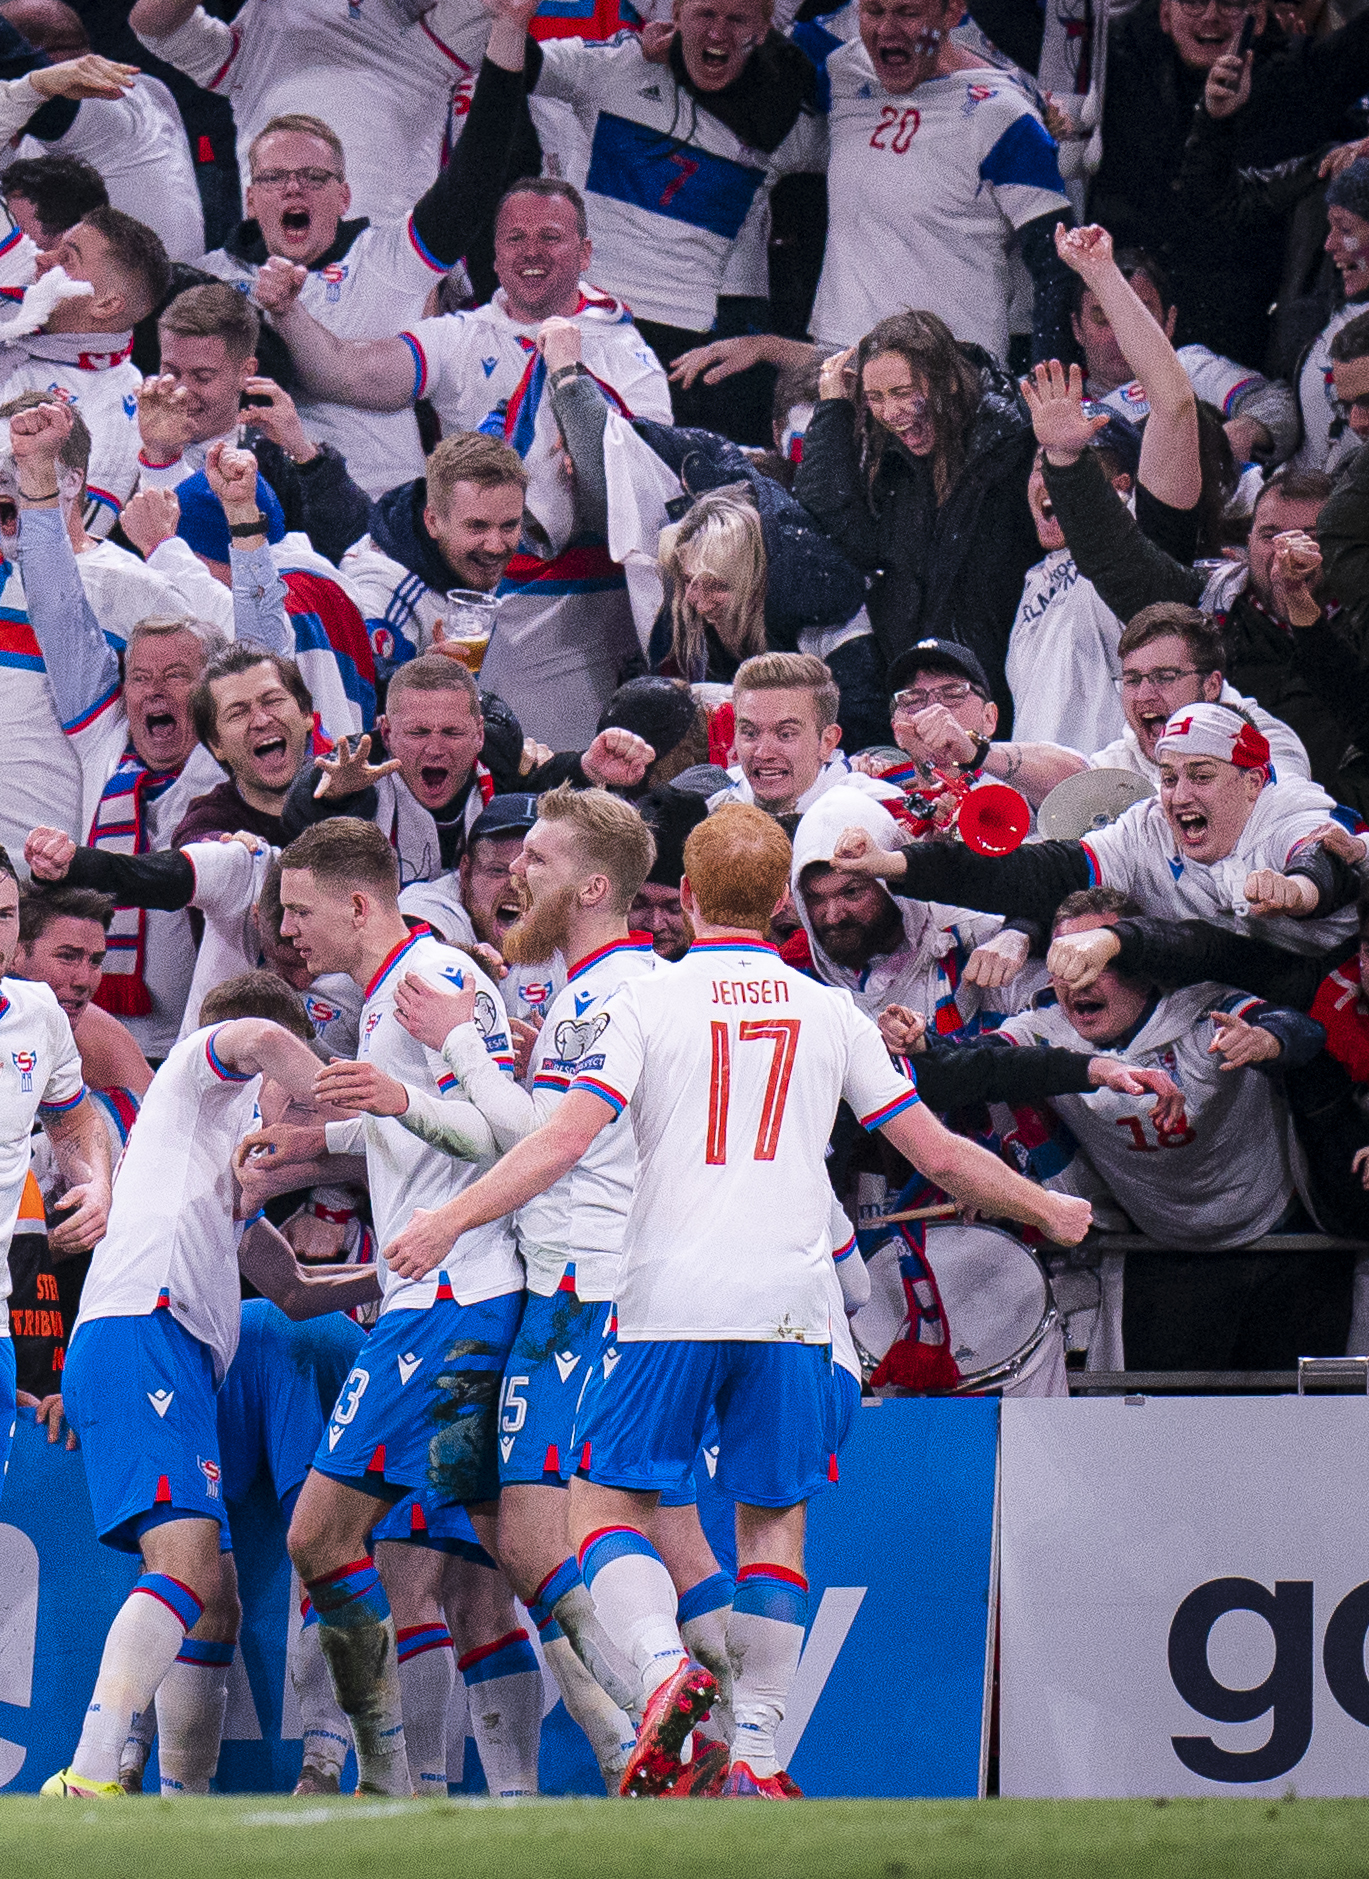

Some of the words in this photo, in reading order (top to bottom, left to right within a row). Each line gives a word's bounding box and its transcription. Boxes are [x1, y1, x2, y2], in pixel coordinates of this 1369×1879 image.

[869, 106, 920, 154] 20
[711, 980, 789, 1005] JENSEN
[705, 1019, 801, 1165] 17
[330, 1367, 370, 1425] 3
[1167, 1576, 1369, 1784] g
